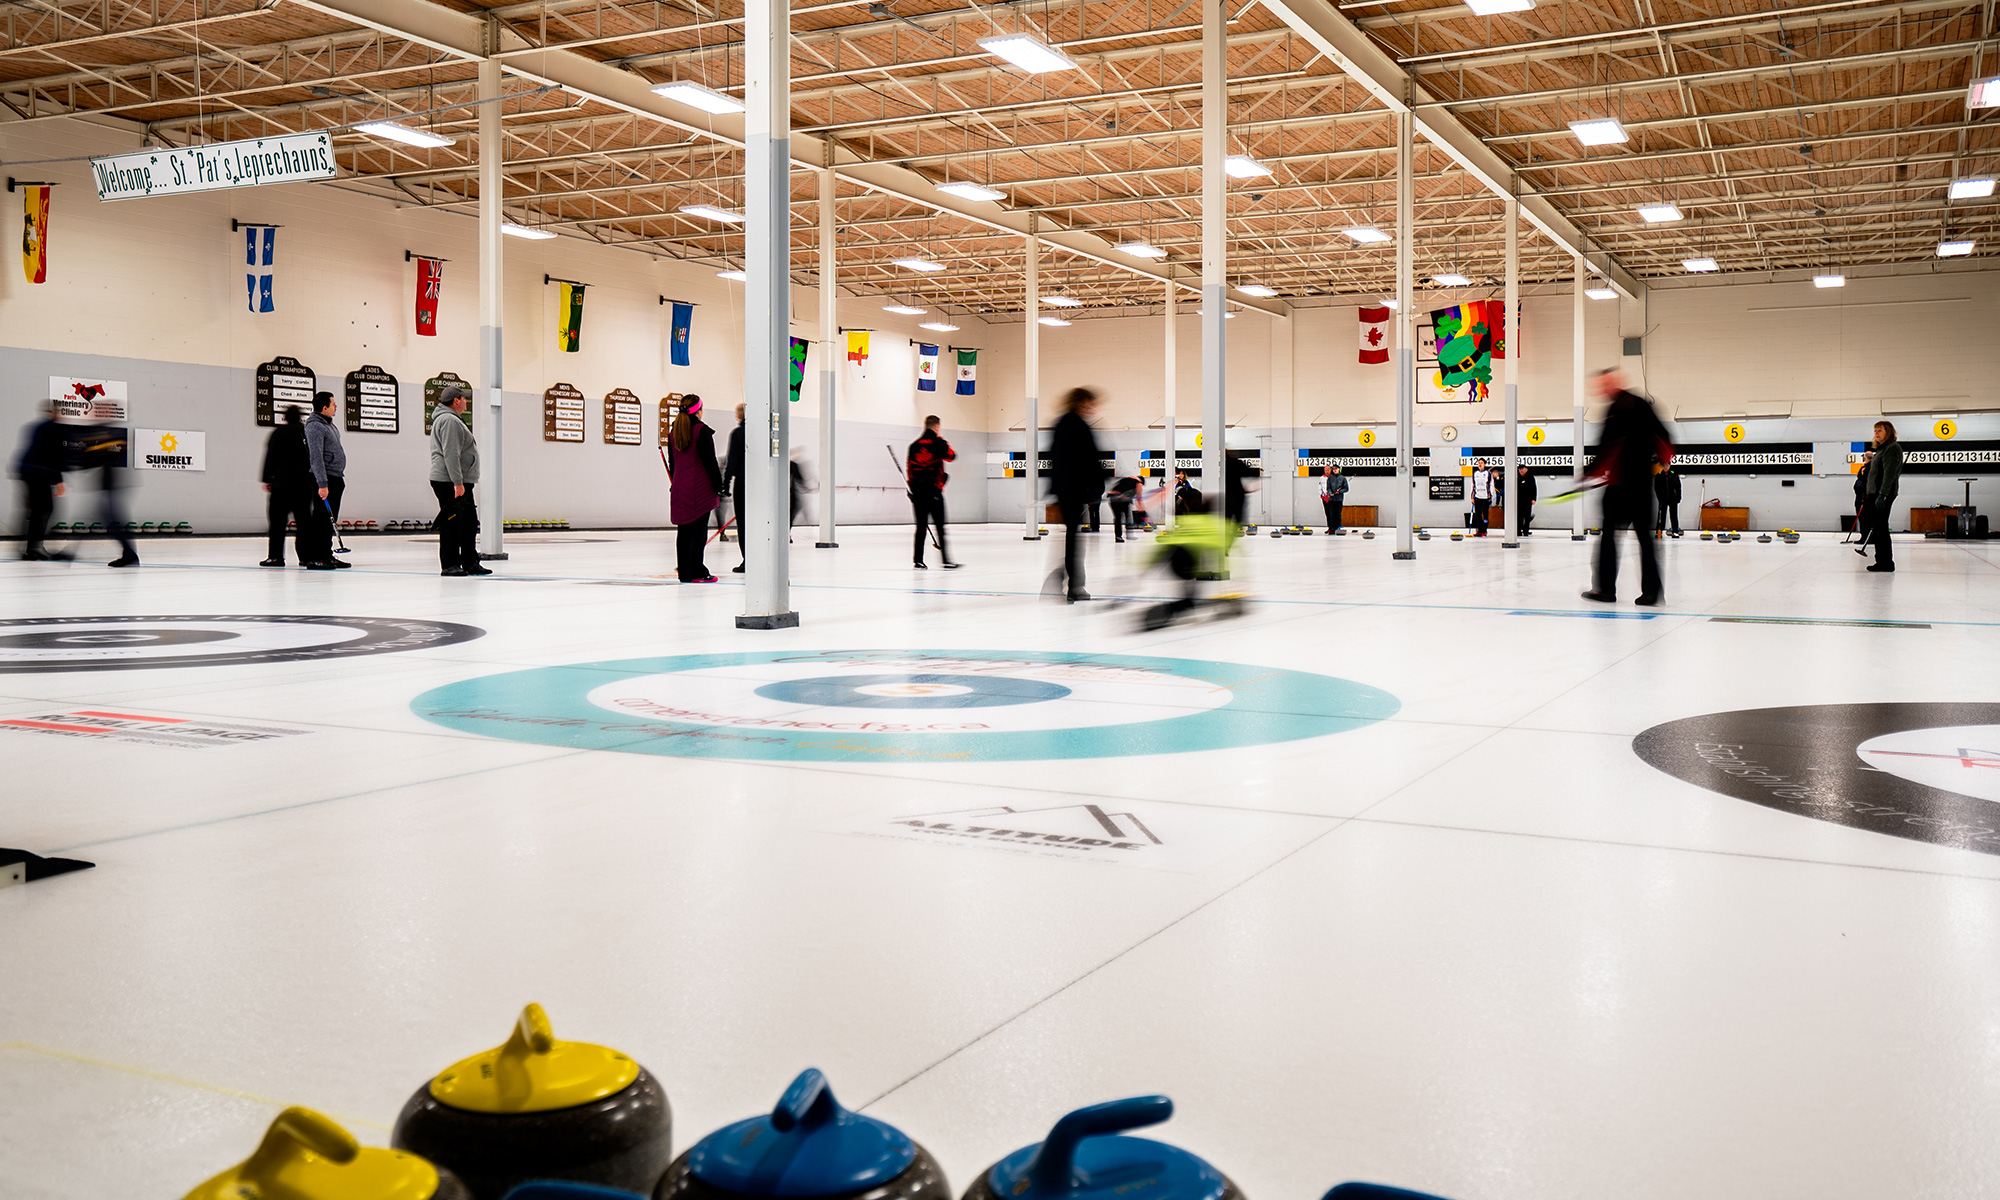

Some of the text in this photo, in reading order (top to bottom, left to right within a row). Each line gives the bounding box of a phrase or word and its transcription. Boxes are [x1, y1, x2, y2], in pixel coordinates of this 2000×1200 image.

[170, 154, 193, 186] St.
[197, 150, 232, 183] Pat's
[235, 142, 328, 185] Leprechauns
[266, 364, 307, 375] CLUB CHAMPIONS
[365, 366, 380, 374] LADIES
[353, 372, 391, 382] CLUB CHAMPIONS
[258, 388, 269, 396] VICE
[53, 399, 89, 409] Veterinary
[61, 408, 81, 416] Clinic
[258, 414, 271, 422] LEAD
[1731, 427, 1739, 438] 5
[1941, 424, 1950, 435] 6
[1364, 433, 1371, 444] 3
[1532, 431, 1540, 441] 4
[146, 454, 193, 466] SUNBELT
[26, 714, 143, 728] ROYAL
[889, 819, 1148, 851] ALTITUDE
